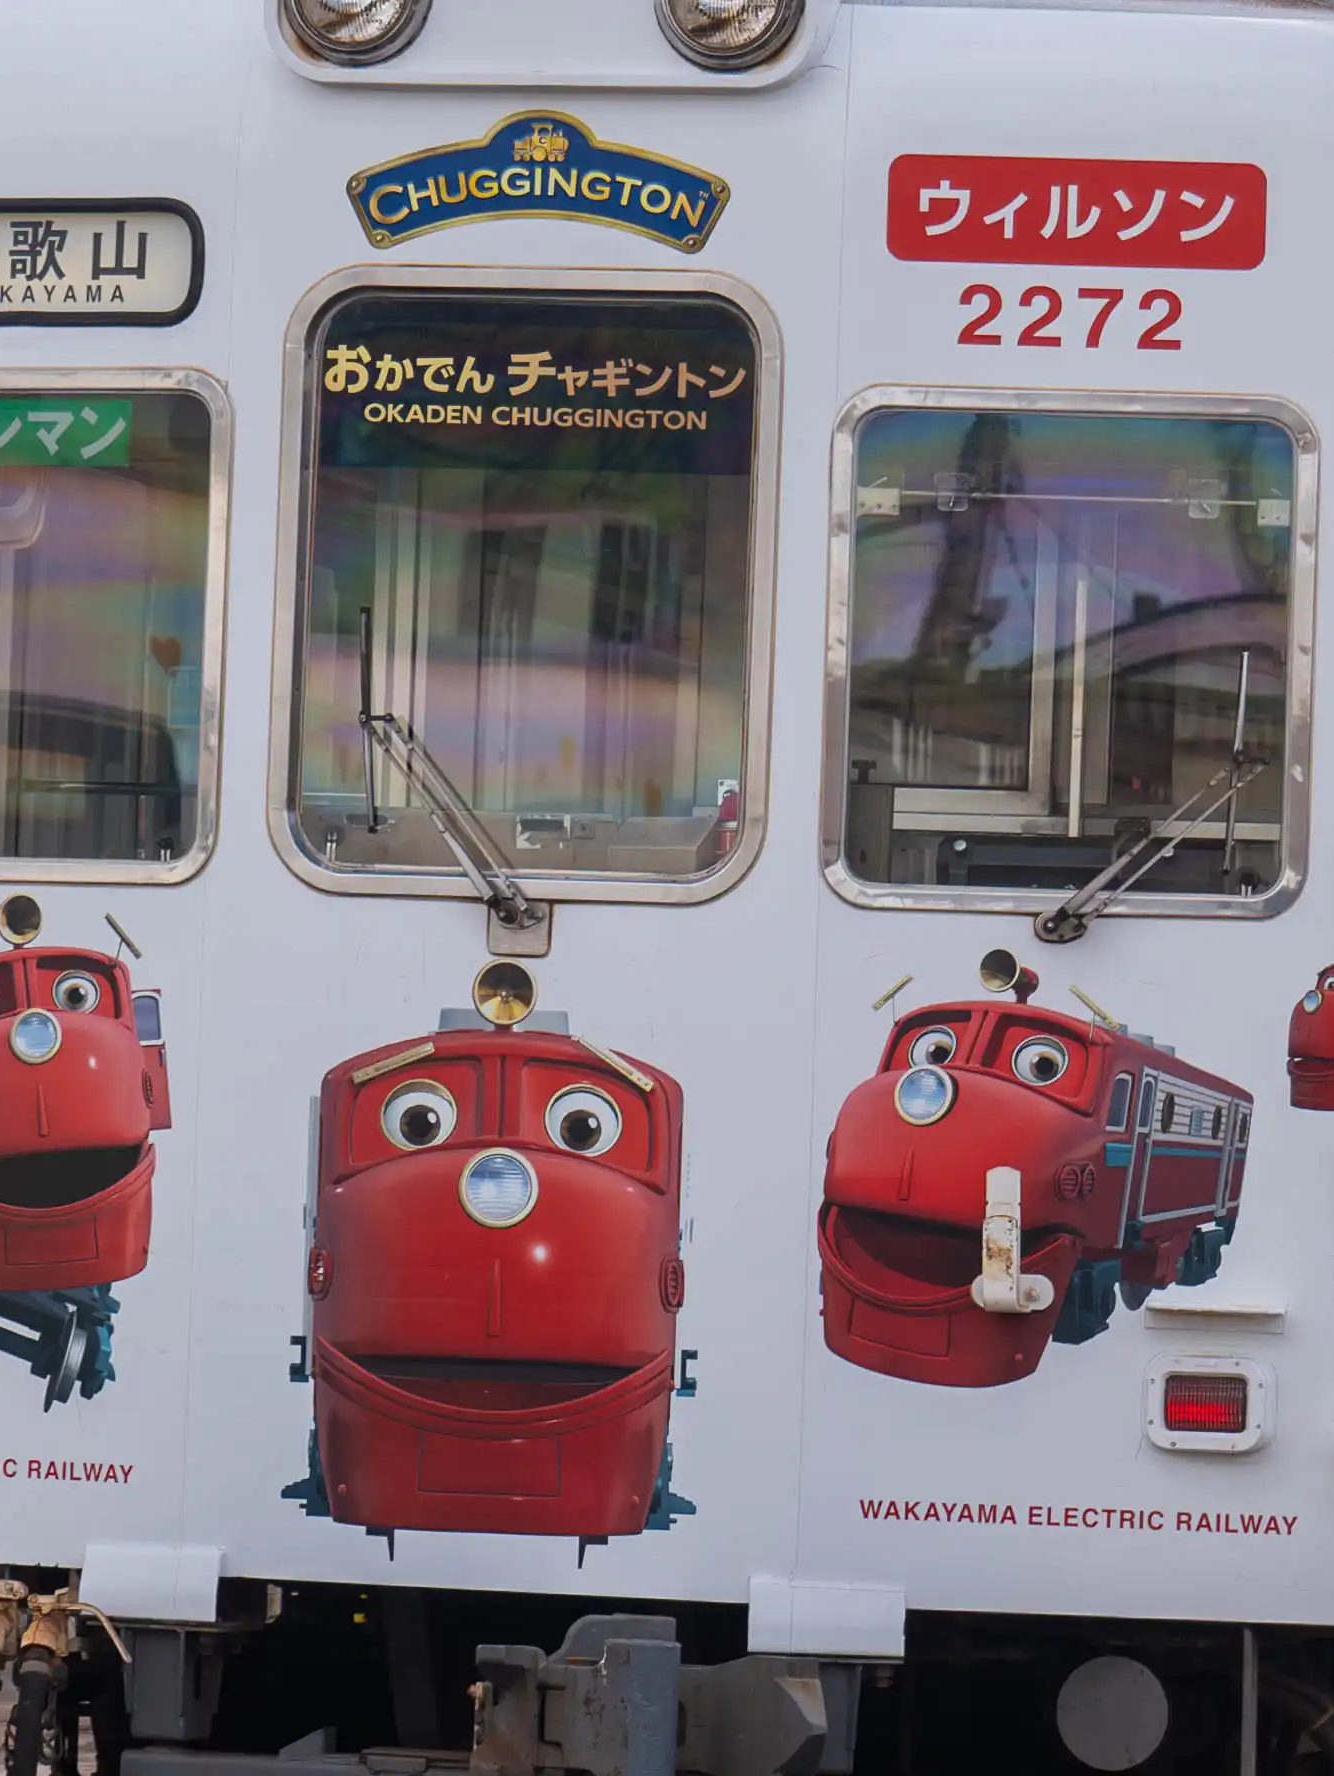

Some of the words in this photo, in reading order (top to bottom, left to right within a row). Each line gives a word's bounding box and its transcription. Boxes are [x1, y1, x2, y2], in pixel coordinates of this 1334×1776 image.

[369, 167, 707, 227] CHUGGINGTON
[919, 180, 1234, 242] ウィルソン
[957, 284, 1182, 351] 2272
[324, 344, 495, 394] おかでん
[507, 351, 747, 400] チャギントン
[364, 402, 482, 425] OKADEN
[491, 405, 707, 431] CHUGGINGTON
[27, 1458, 135, 1485] RAILWAY
[859, 1499, 1018, 1526] WAKAYAMA
[1027, 1504, 1165, 1532] ELECTRIC
[1176, 1509, 1299, 1537] RAILWAY
